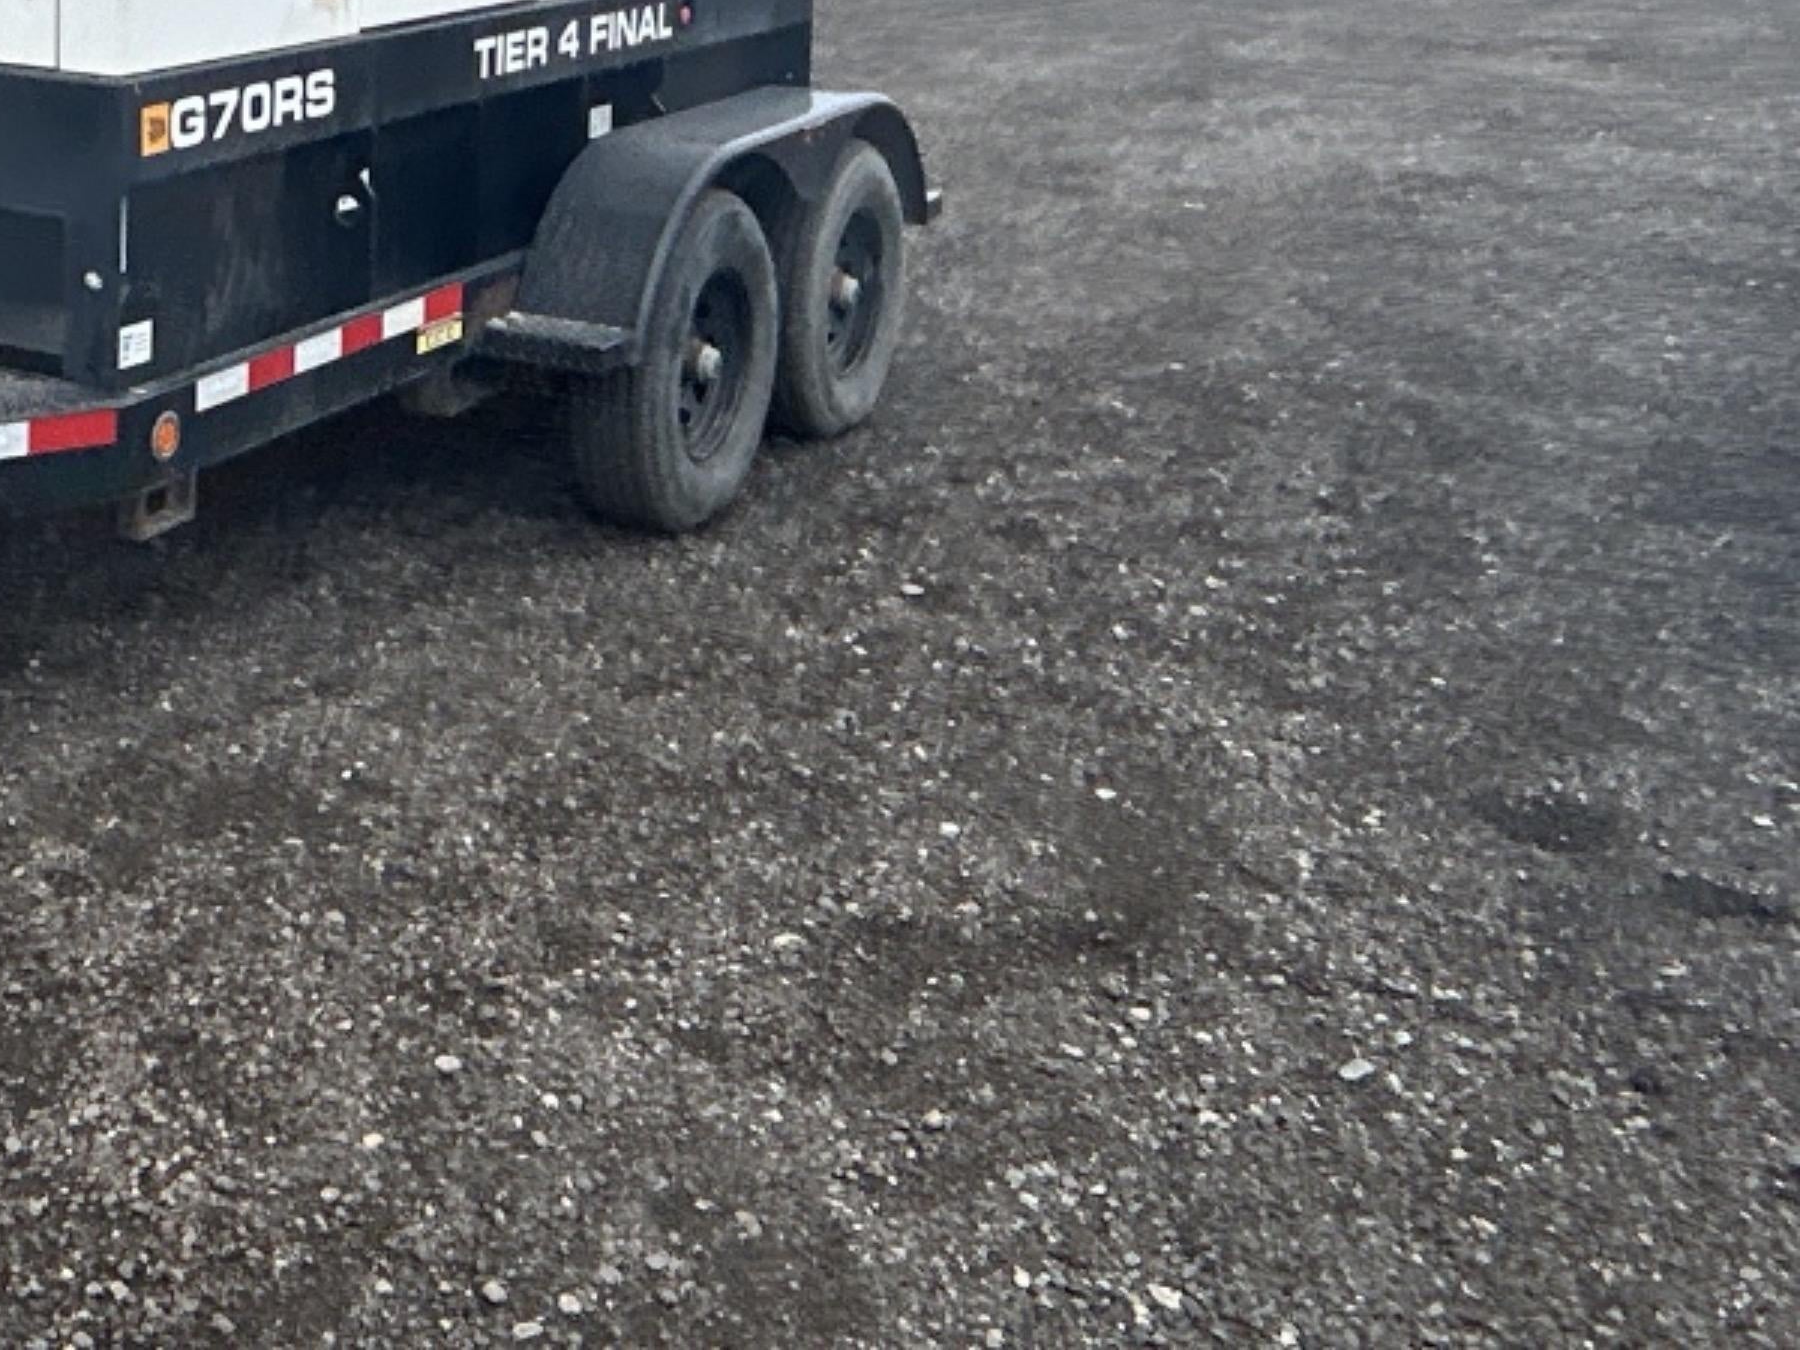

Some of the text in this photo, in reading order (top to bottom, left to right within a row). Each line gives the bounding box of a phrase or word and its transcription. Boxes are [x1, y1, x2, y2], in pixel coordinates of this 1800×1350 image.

[473, 3, 673, 79] TIER 4 FINAL
[170, 68, 335, 149] G70RS
